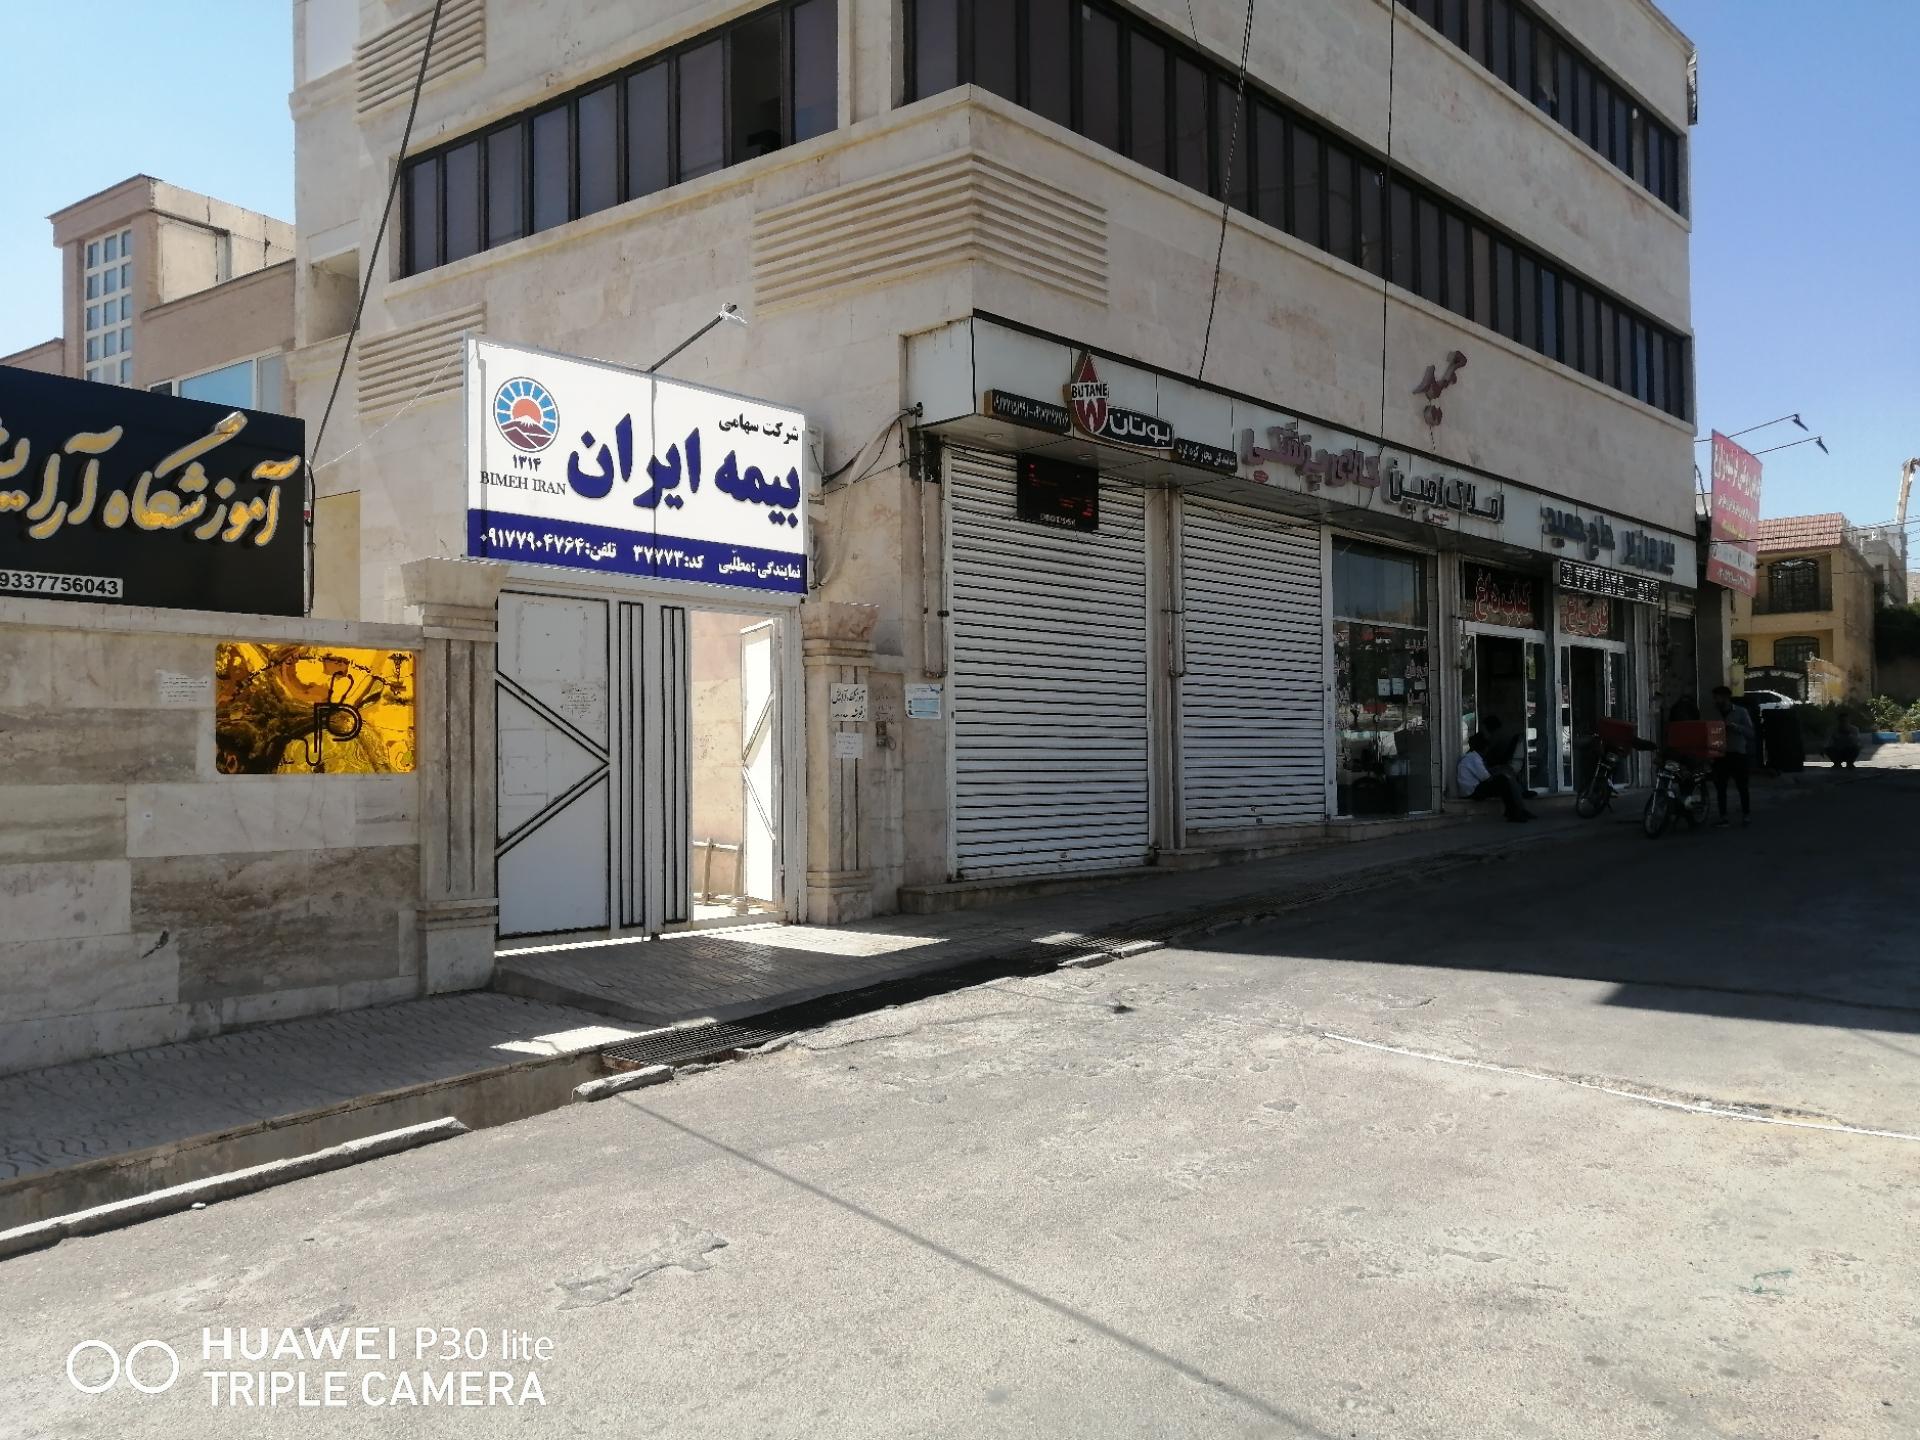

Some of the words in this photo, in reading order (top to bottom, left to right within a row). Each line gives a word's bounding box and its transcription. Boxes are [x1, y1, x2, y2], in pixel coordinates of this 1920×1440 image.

[1071, 383, 1108, 399] BUTANE
[718, 412, 759, 435] سهامی
[763, 422, 799, 444] شرکت
[1109, 412, 1170, 446] بوتان
[512, 454, 542, 472] ۱۳۱۴
[567, 412, 703, 511] ایران
[104, 411, 300, 547] آموزشگاه
[480, 470, 529, 490] BIMEH
[532, 478, 566, 496] IRAN
[714, 449, 801, 529] بیمه
